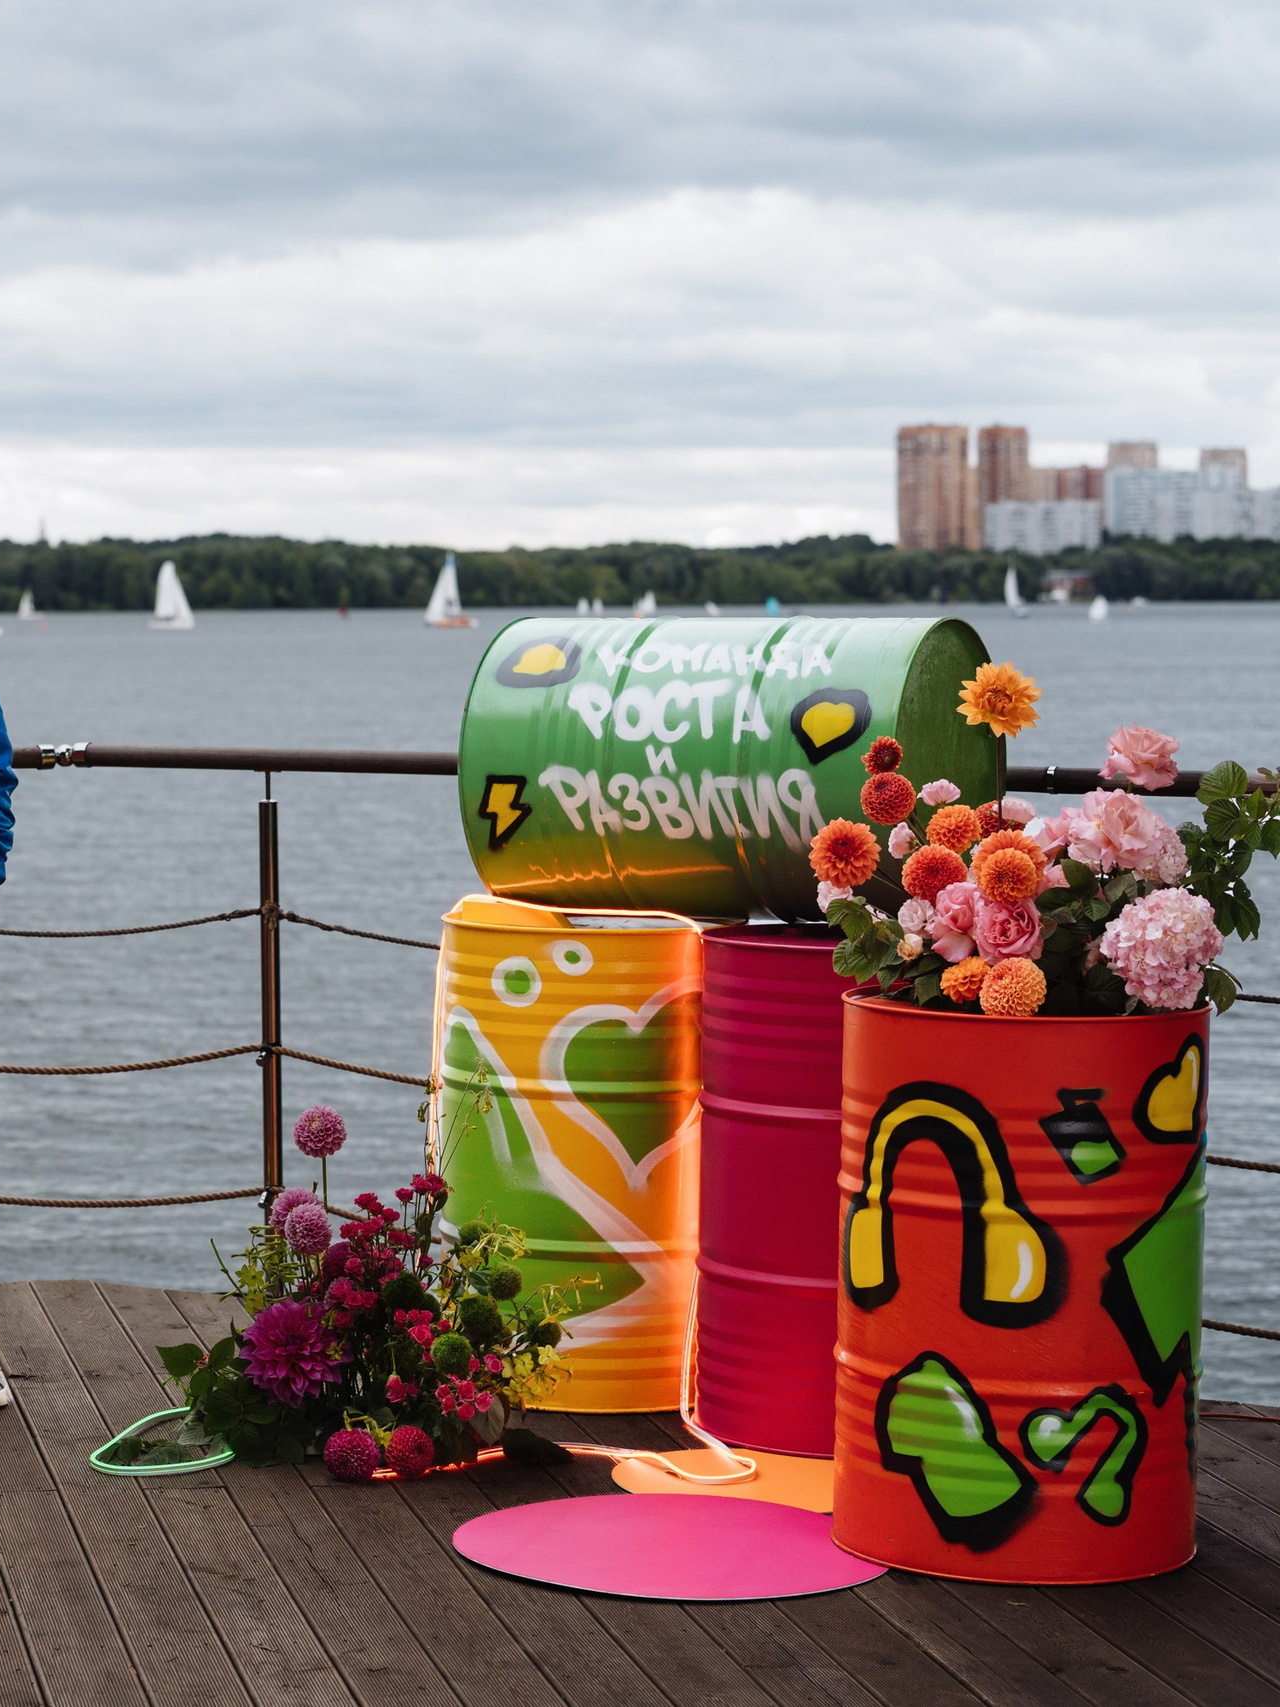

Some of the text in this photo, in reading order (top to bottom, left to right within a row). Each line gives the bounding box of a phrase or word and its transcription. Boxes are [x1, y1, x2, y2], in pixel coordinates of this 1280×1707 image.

[596, 641, 833, 680] КОМАНДА
[567, 679, 772, 744] РОСТА
[538, 763, 827, 855] РАЗВИТИЯ
